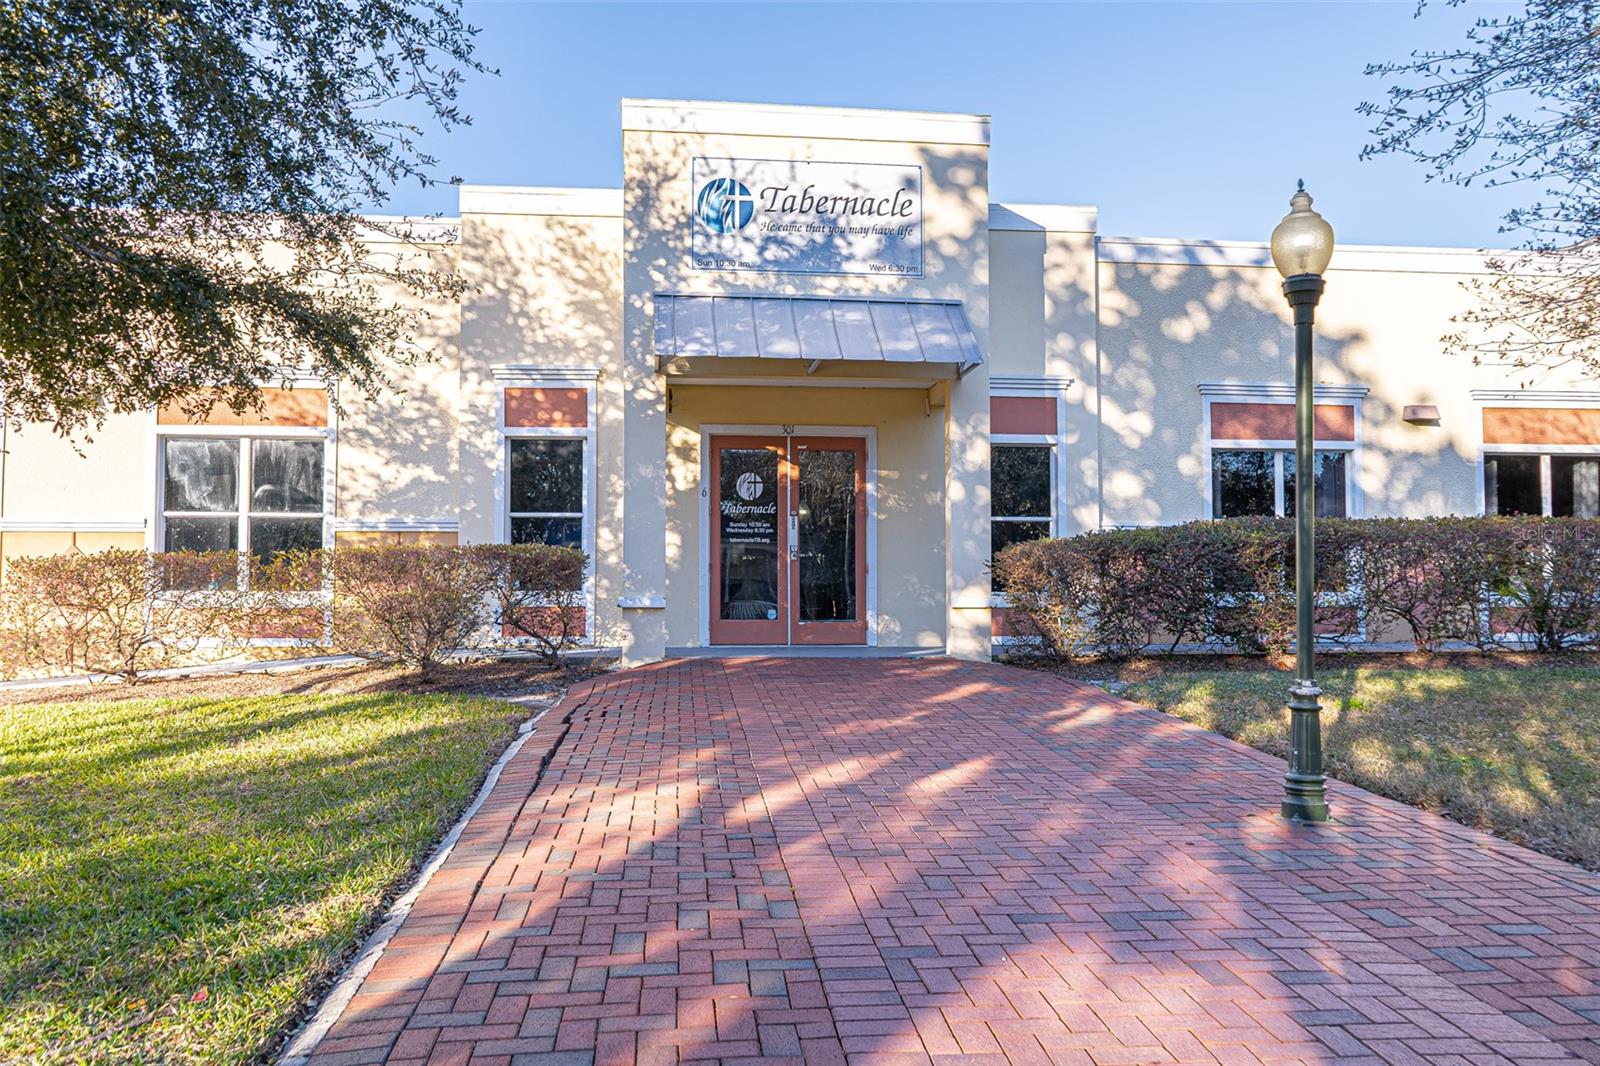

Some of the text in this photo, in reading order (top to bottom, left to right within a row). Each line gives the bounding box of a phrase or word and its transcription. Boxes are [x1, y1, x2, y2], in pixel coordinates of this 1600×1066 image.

[760, 185, 913, 217] Tabernacle
[761, 221, 913, 240] He came that you may have life
[697, 259, 713, 267] Sun
[869, 263, 919, 275] Wed 6:30 pm
[781, 424, 795, 435] 301
[701, 487, 707, 498] 6
[721, 502, 777, 514] Tabernacle
